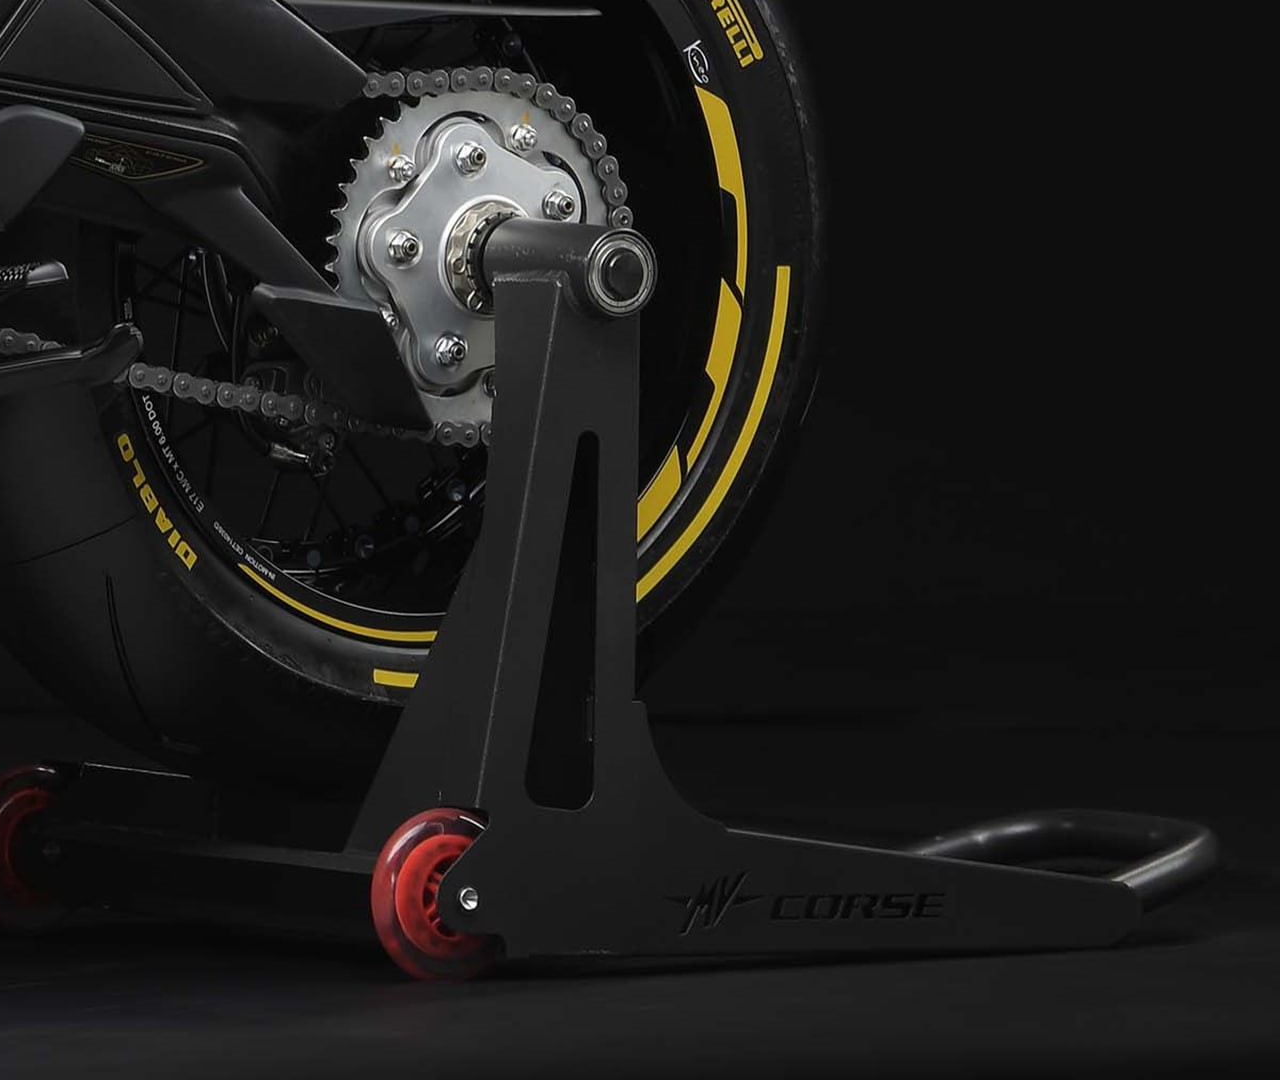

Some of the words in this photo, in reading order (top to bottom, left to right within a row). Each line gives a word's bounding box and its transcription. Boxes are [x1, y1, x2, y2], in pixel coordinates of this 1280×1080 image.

[141, 394, 157, 421] DOT
[161, 445, 176, 465] MT
[115, 432, 200, 571] DIABLO
[768, 892, 946, 921] CORSE
